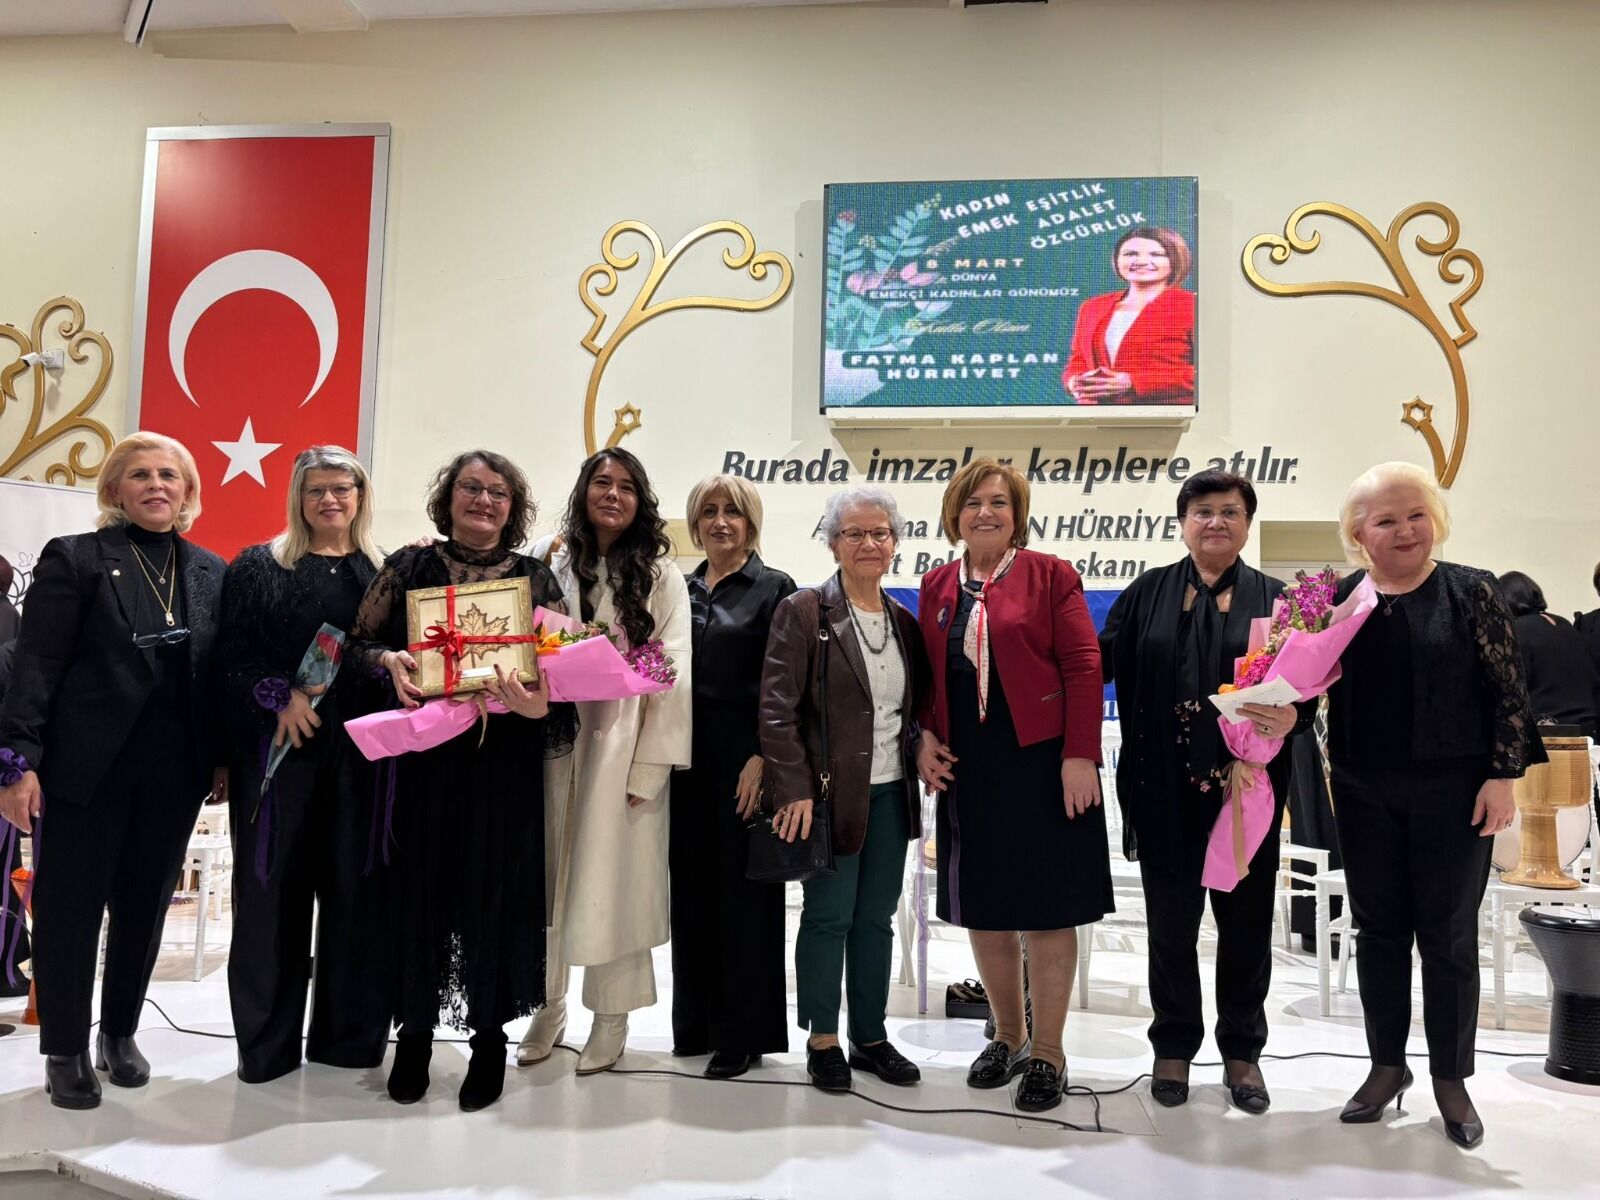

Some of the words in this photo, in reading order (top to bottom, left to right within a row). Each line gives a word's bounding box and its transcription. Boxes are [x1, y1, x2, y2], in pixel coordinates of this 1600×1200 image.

[940, 193, 1010, 220] KADIN
[1026, 183, 1105, 211] EŞİTLİK
[958, 213, 1019, 238] EMEK
[1039, 199, 1116, 229] ADALET
[1030, 211, 1147, 249] ÖZGÜRLÜK
[926, 259, 938, 269] 8
[954, 258, 1024, 269] MART
[951, 272, 997, 281] DÜNYA
[869, 288, 923, 300] EMEKÇİ
[929, 289, 1002, 298] KADINLAR
[1008, 287, 1080, 297] GÜNÜMÜZ
[850, 354, 935, 365] FATMA
[951, 353, 1059, 365] KAPLAN
[887, 366, 1020, 379] HÜRRİYET
[722, 448, 849, 482] Burada
[1026, 446, 1191, 493] kalplere
[1055, 508, 1184, 539] HÜRRİYE
